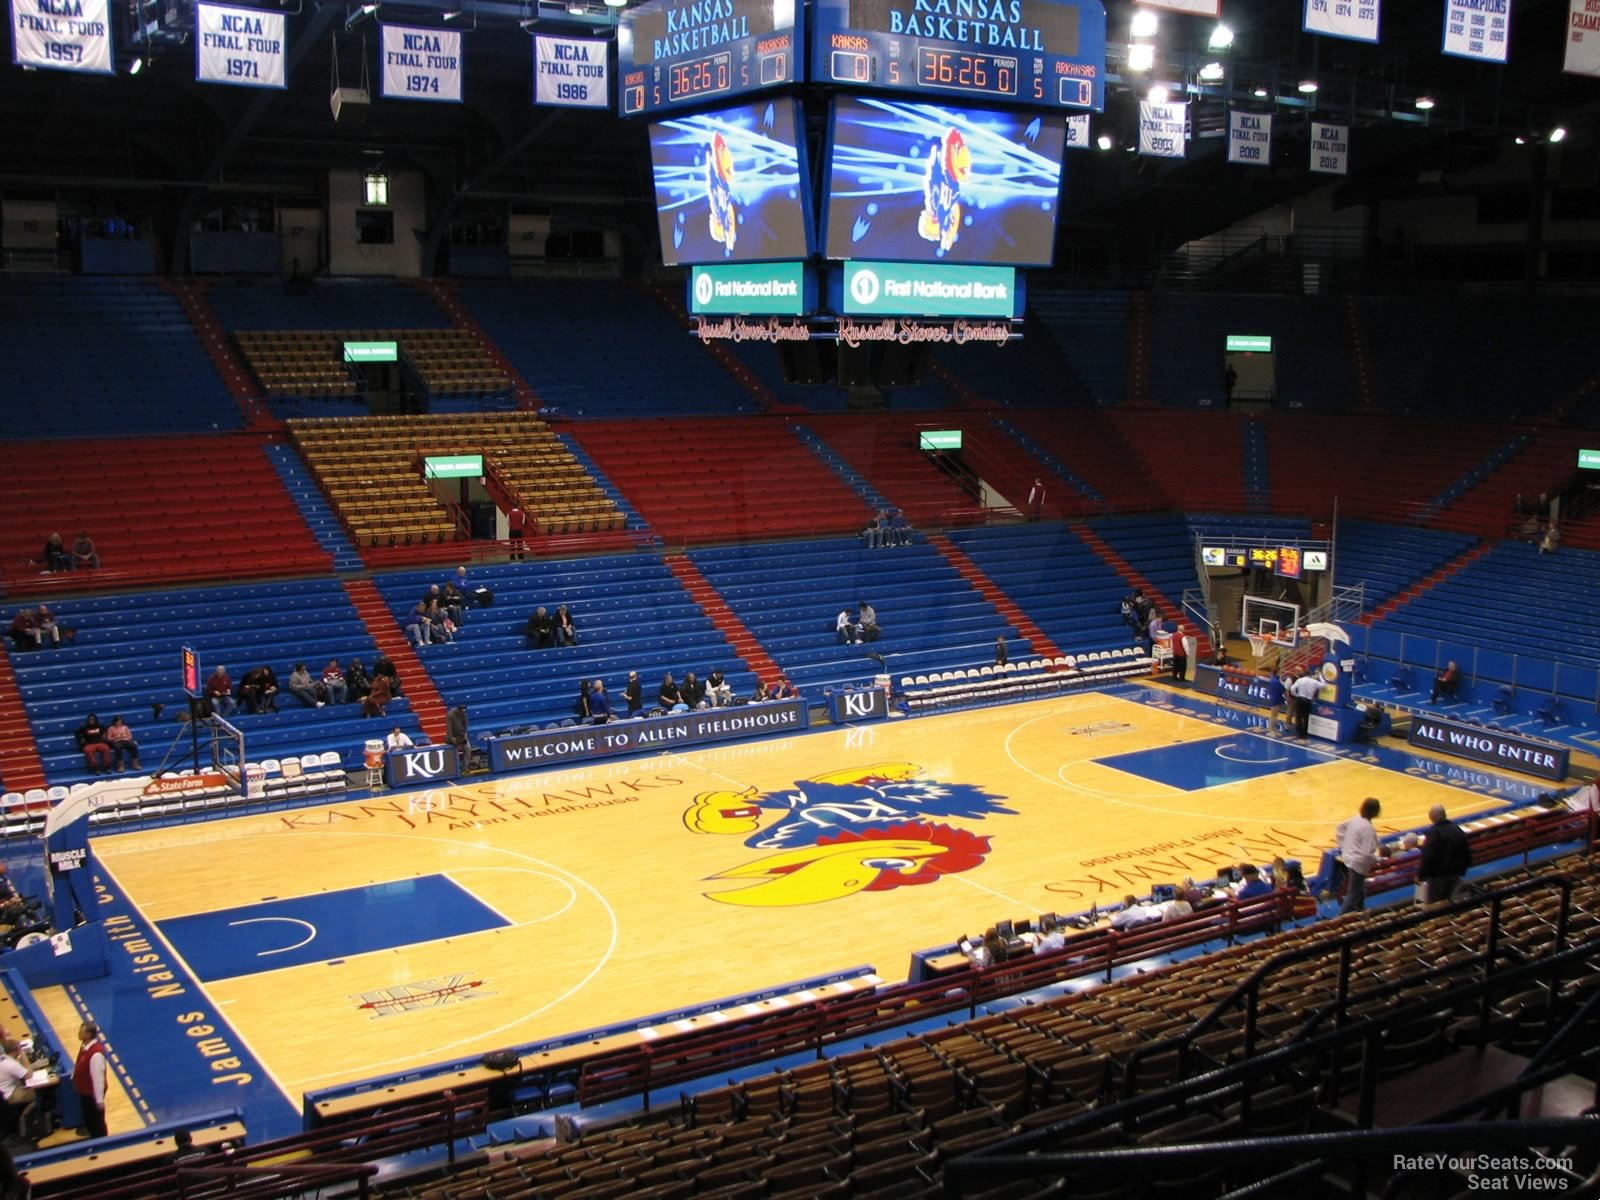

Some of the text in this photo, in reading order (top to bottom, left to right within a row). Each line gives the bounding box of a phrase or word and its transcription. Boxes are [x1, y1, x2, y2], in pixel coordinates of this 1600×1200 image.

[38, 0, 83, 17] NCAA
[667, 0, 733, 33] KANSAS
[19, 14, 104, 37] FINAL FOUR
[221, 14, 263, 35] NCAA
[890, 11, 1044, 51] BASKETBALL
[203, 34, 280, 54] FINAL FOUR
[403, 34, 441, 53] NCAA
[654, 16, 749, 60] BASKETBALL
[831, 34, 868, 50] KANSAS
[44, 41, 84, 62] 1957
[554, 44, 589, 62] NCAA
[226, 58, 258, 78] 1971
[387, 54, 457, 70] FINAL FOUR
[540, 61, 604, 79] FINAL FOUR
[776, 55, 785, 80] 0
[854, 56, 867, 80] 0
[890, 62, 899, 82] 5
[925, 53, 1009, 91] 36:26 0
[993, 58, 1014, 69] PERIOD
[1055, 61, 1096, 78] ARKANSAS
[406, 75, 439, 93] 1974
[718, 65, 726, 88] 0
[557, 83, 587, 100] 1986
[653, 86, 660, 104] 5
[1034, 78, 1043, 98] 5
[1079, 82, 1089, 104] 0
[636, 88, 643, 109] 0
[1151, 107, 1173, 120] NCAA
[1240, 117, 1260, 130] NCAA
[1142, 120, 1183, 133] FINAL FOUR
[1231, 129, 1268, 142] FINAL FOUR
[1320, 128, 1339, 140] NCAA
[1151, 138, 1174, 151] 2003
[1239, 146, 1260, 159] 2008
[1312, 140, 1346, 153] FINAL FOUR
[1320, 156, 1338, 169] 2012
[715, 280, 797, 297] First National Bank
[884, 279, 1007, 299] First National Bank
[697, 315, 810, 345] Russell Stover Candies
[838, 316, 1010, 348] Russell Stover Candies
[845, 691, 875, 716] KU
[506, 710, 797, 761] WELCOME TO ALLEN FIELDHOUSE
[1416, 724, 1556, 768] ALL WHO ENTER
[404, 750, 445, 778] KU
[87, 795, 105, 807] KU
[280, 786, 505, 830] KANSAS
[396, 772, 684, 830] JAYHAWKS
[447, 794, 641, 831] Allen Fieldhouse
[51, 848, 87, 863] MUSCLE
[1078, 826, 1244, 868] Allen Fieldhouse
[58, 860, 81, 872] MILK
[1044, 826, 1310, 899] JAYHAWKS
[103, 914, 253, 1086] James Naismith
